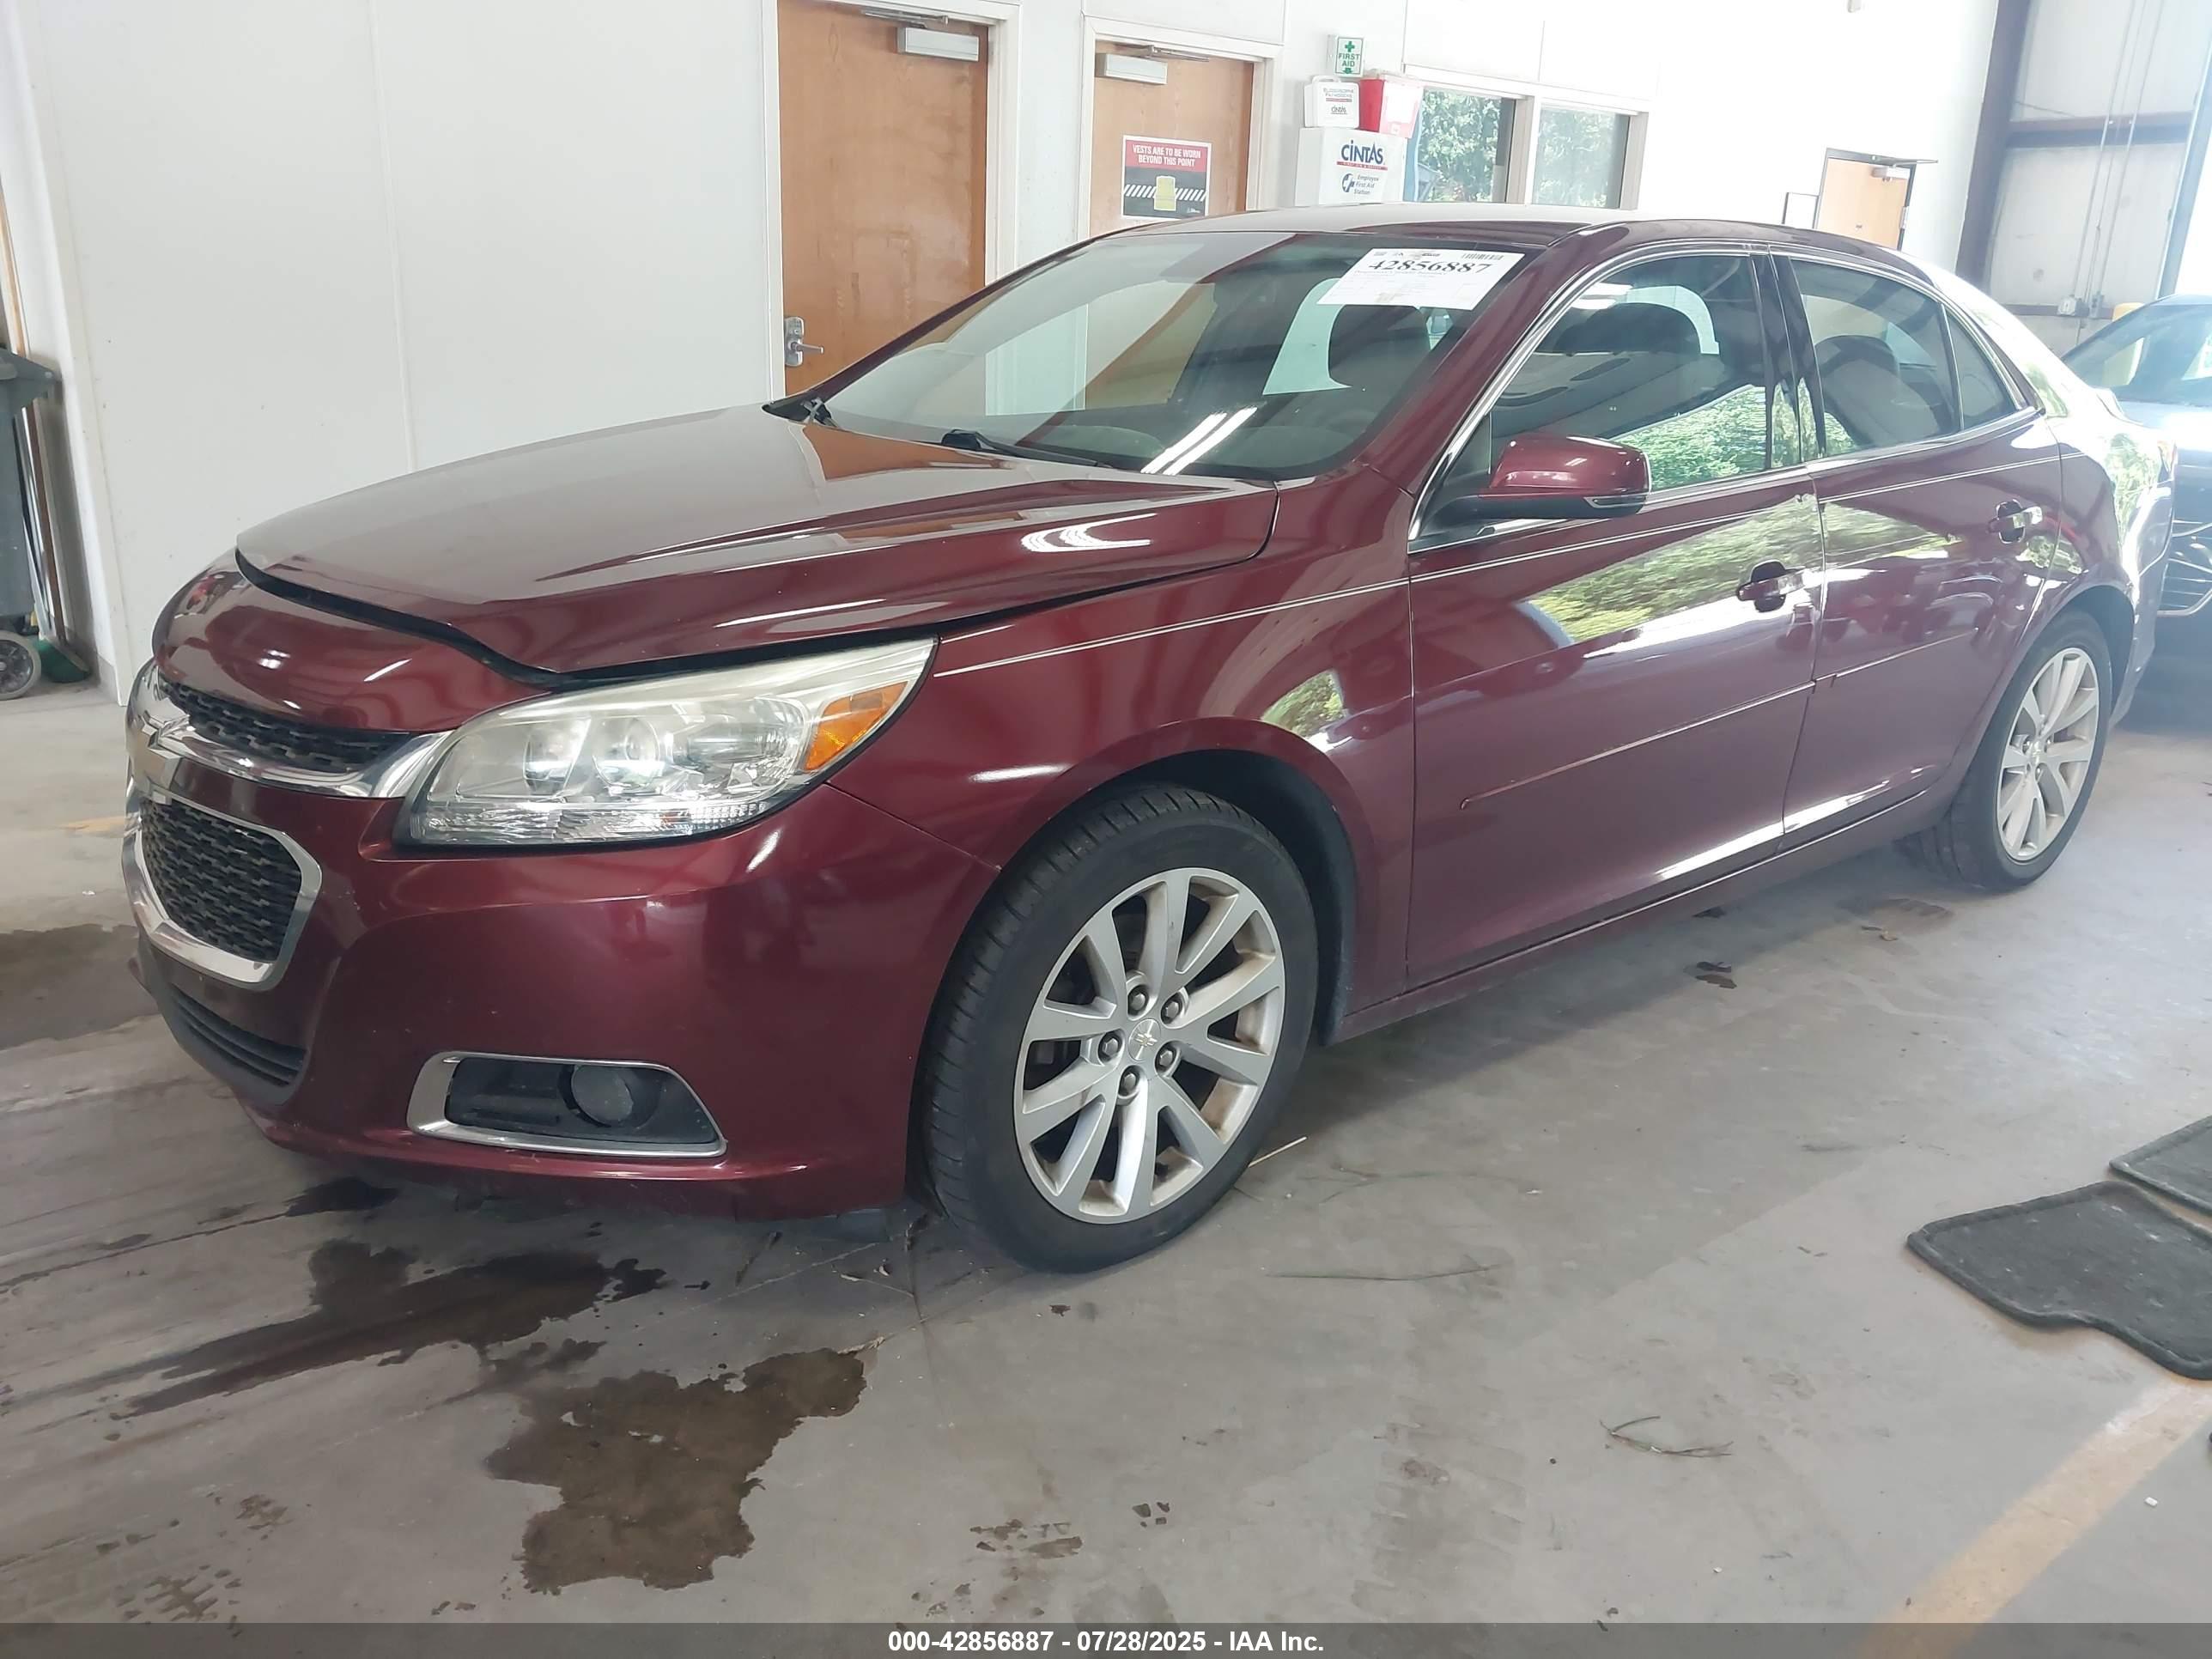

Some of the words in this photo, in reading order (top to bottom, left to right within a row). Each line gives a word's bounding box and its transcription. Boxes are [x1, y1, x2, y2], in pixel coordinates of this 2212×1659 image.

[1133, 143, 1152, 155] VESTS
[1152, 147, 1165, 155] ARE
[1165, 148, 1173, 156] TO
[1174, 149, 1182, 157] BE
[1182, 149, 1201, 159] WORN
[1138, 154, 1163, 165] BEYOND
[1164, 156, 1176, 166] THIS
[1177, 158, 1195, 167] POINT
[1368, 259, 1493, 274] 42856887
